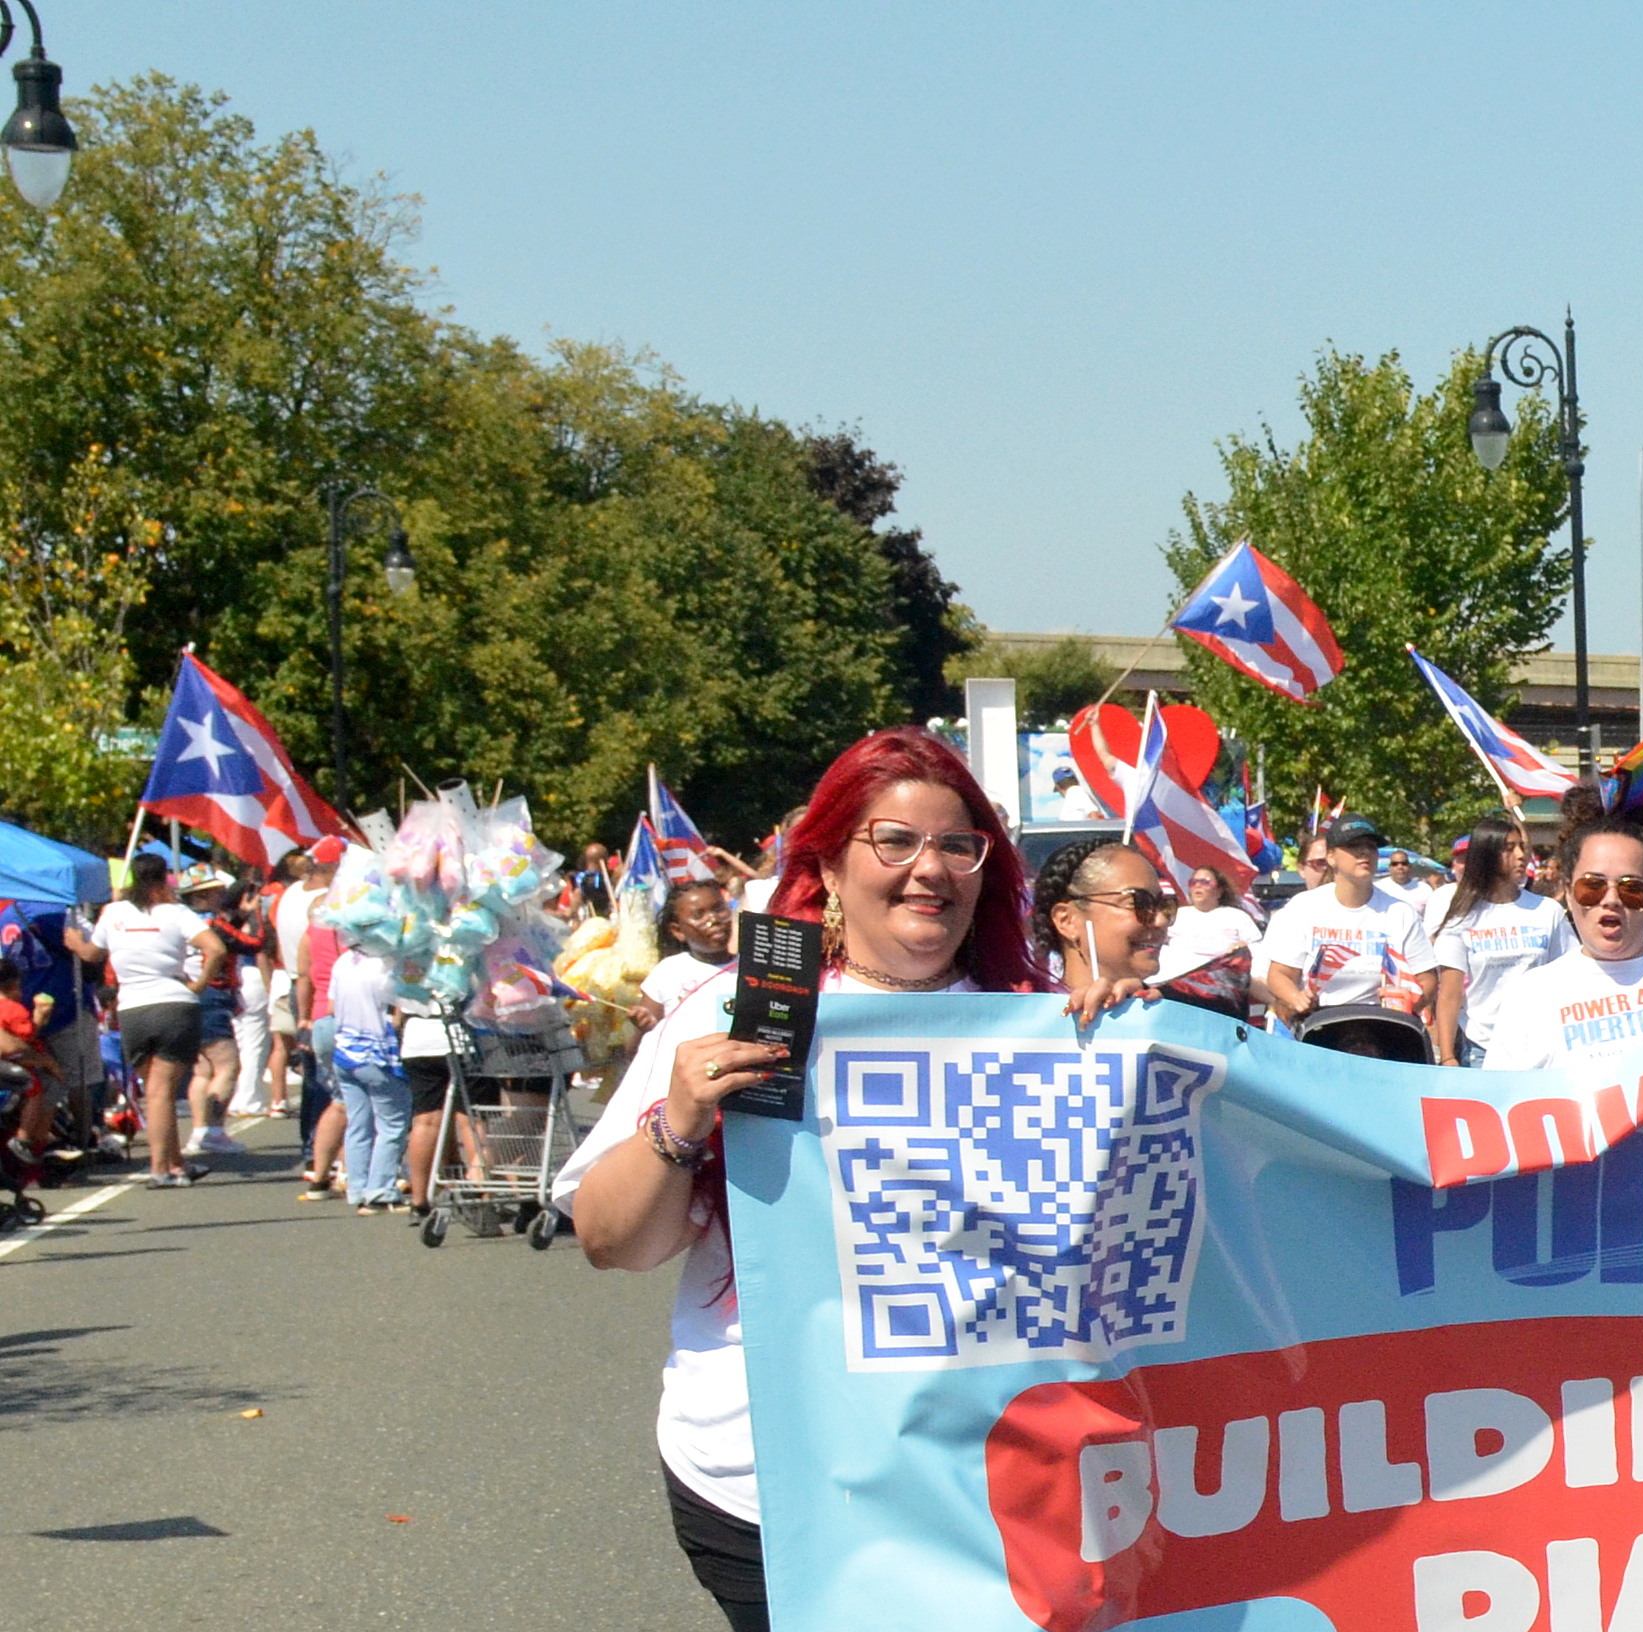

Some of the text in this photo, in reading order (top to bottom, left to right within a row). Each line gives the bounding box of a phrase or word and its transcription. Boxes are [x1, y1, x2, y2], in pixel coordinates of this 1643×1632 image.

[1312, 926, 1364, 942] POWER 4
[1468, 925, 1519, 941] POWER 4
[1560, 993, 1632, 1025] POWER
